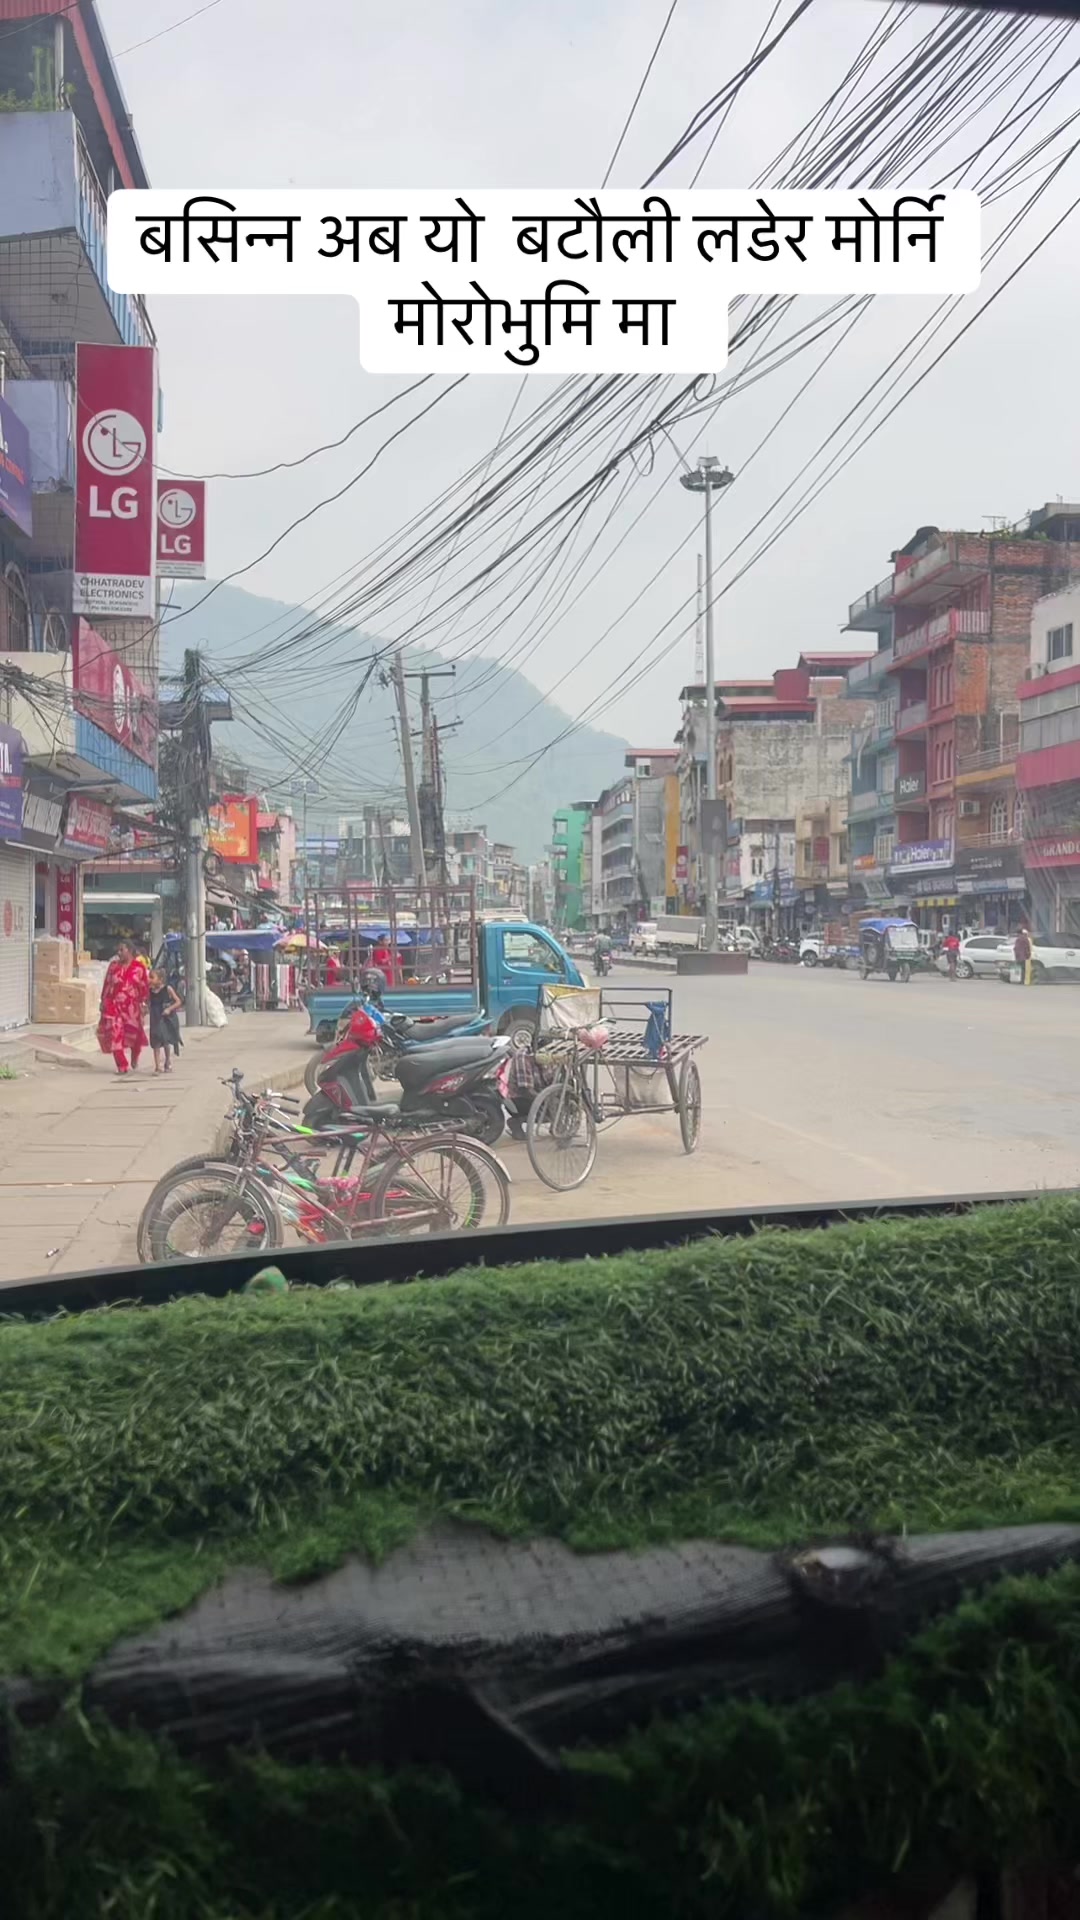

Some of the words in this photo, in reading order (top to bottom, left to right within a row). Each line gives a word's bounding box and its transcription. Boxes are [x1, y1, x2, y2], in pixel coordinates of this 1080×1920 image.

[89, 485, 138, 520] LG
[160, 534, 192, 554] LG
[80, 577, 145, 589] CHHATRADEV
[80, 589, 145, 600] ELECTRONICS
